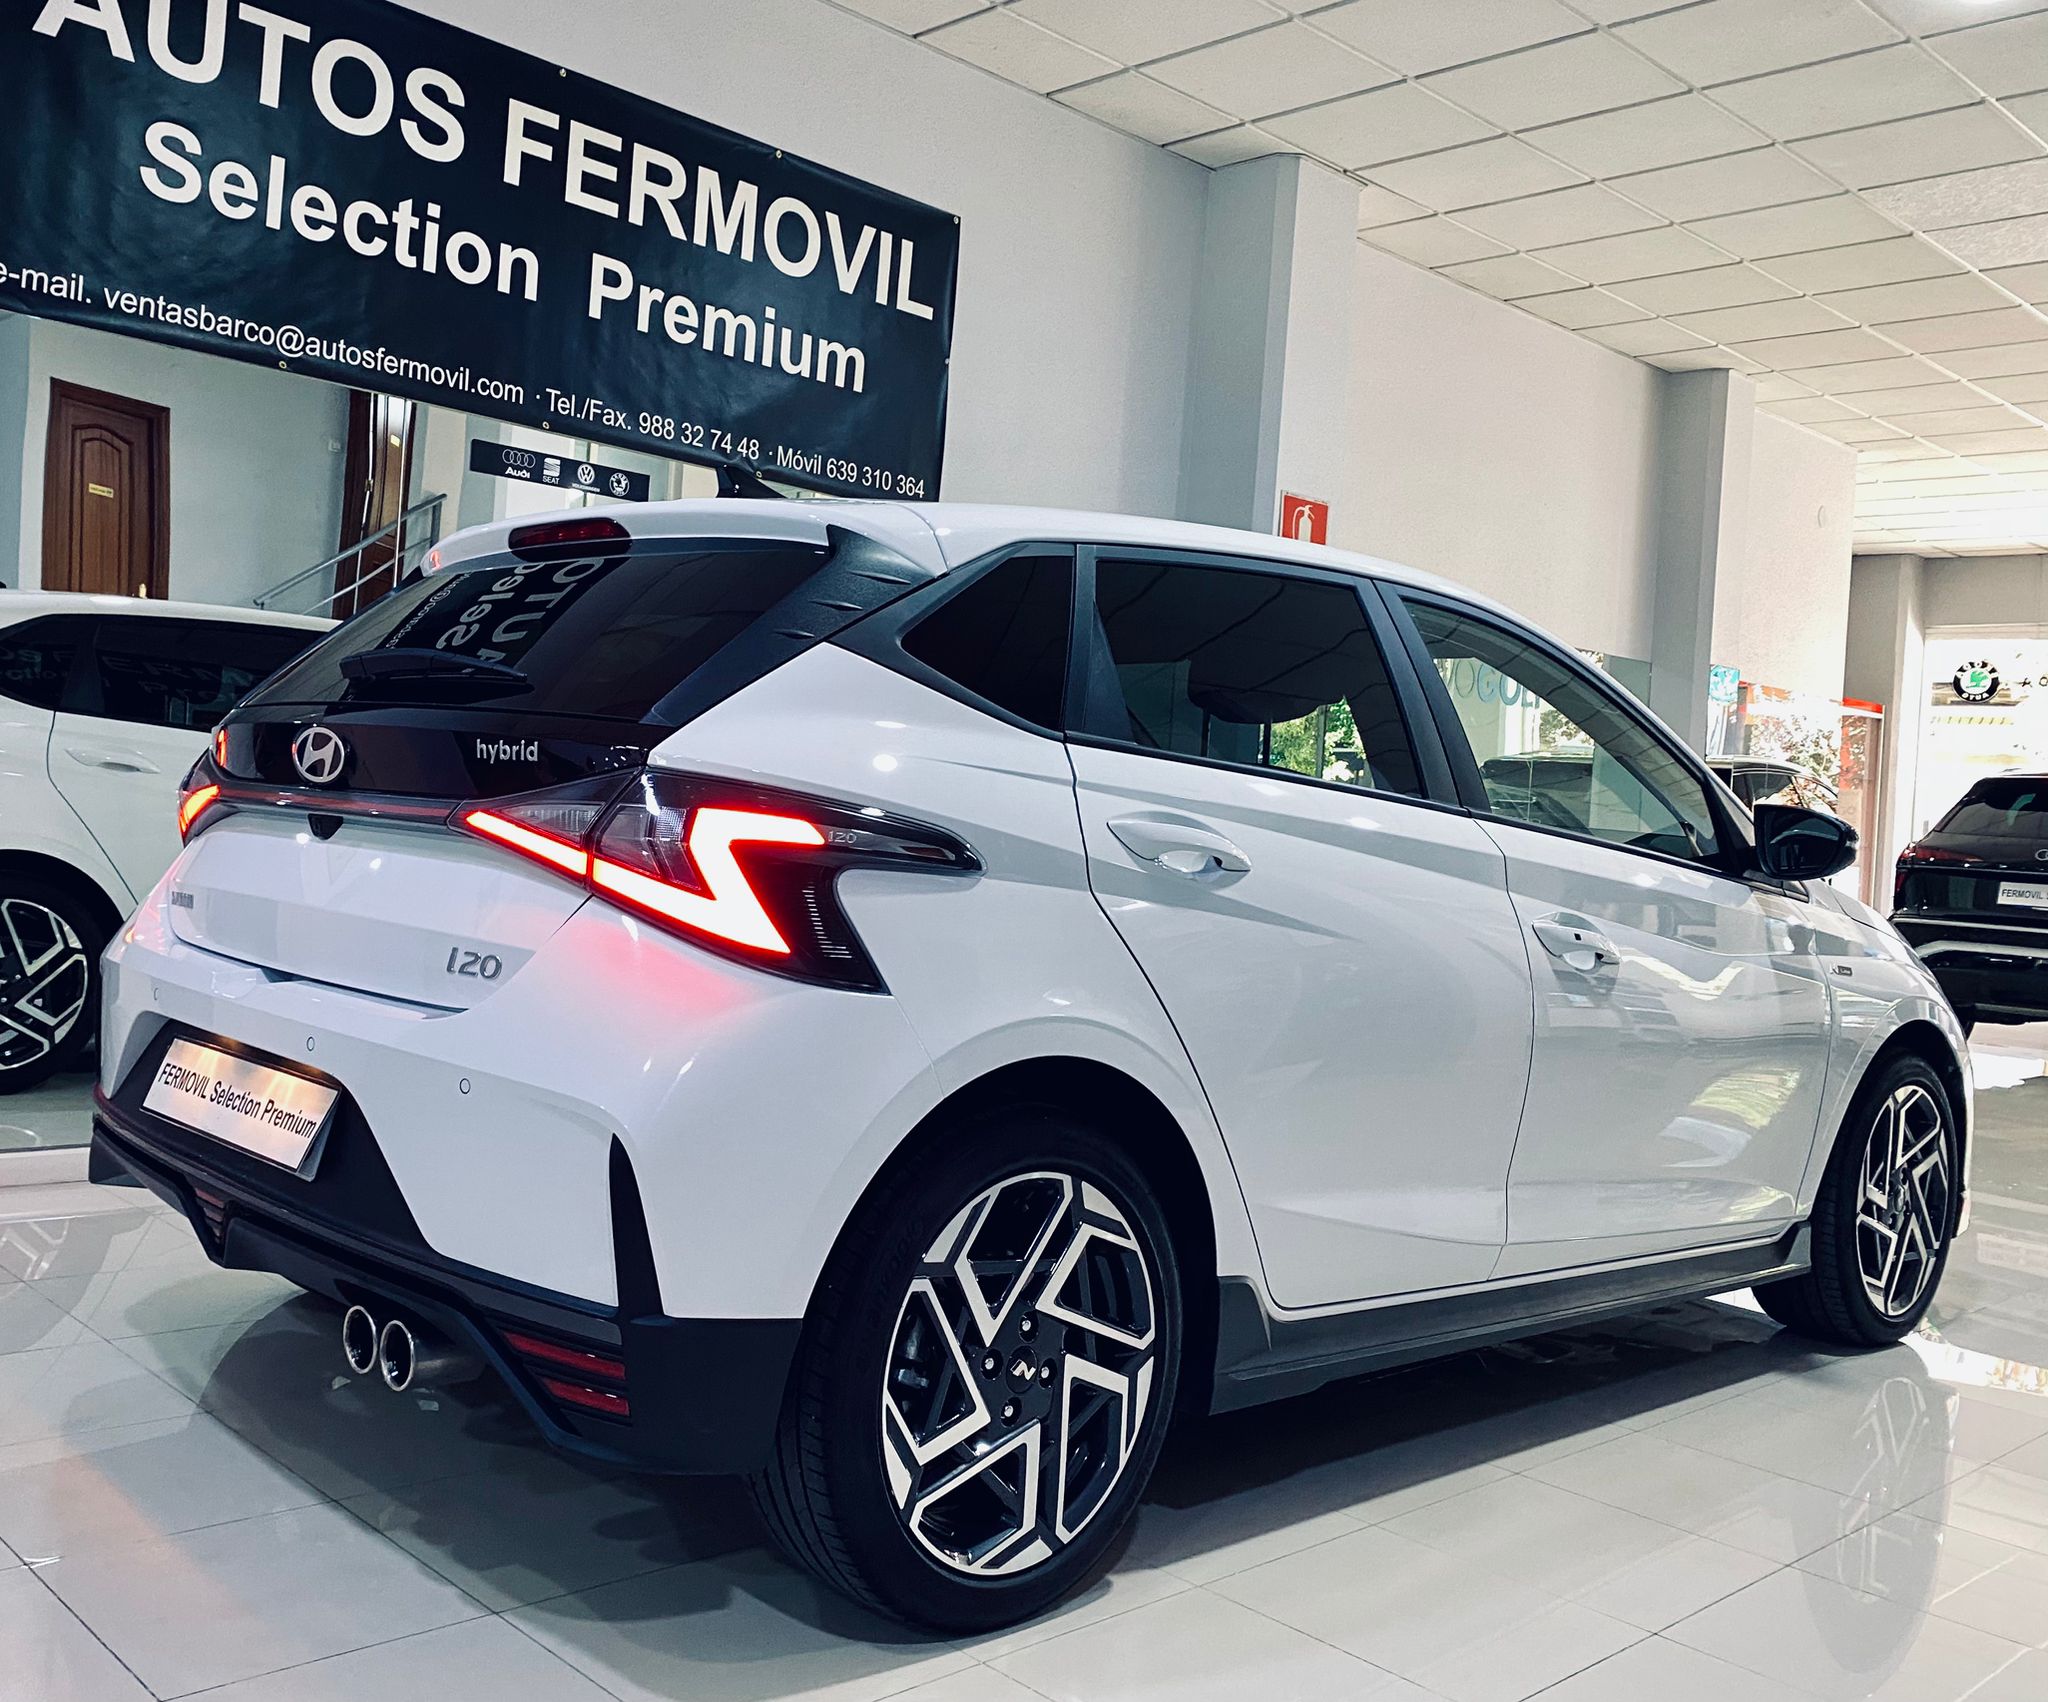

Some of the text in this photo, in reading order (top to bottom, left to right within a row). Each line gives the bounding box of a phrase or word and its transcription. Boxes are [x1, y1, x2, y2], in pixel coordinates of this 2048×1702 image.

[32, 0, 935, 321] AUTOS FERMOVIL
[139, 121, 867, 393] Selection Premium
[103, 287, 524, 405] ventasbarco@autosfermovil.com
[638, 412, 675, 441] 988
[680, 421, 704, 448] 32
[710, 429, 733, 455] 74
[737, 436, 760, 460] 48
[776, 445, 821, 476] Móvil
[826, 457, 857, 483] 639
[862, 466, 892, 491] 310
[896, 473, 925, 499] 364
[504, 466, 531, 479] Audi
[542, 475, 560, 485] SEAT
[476, 738, 539, 765] hybrid
[2001, 888, 2043, 900] FERMOVIL
[158, 1062, 317, 1140] FERMOVIL Selection Premium
